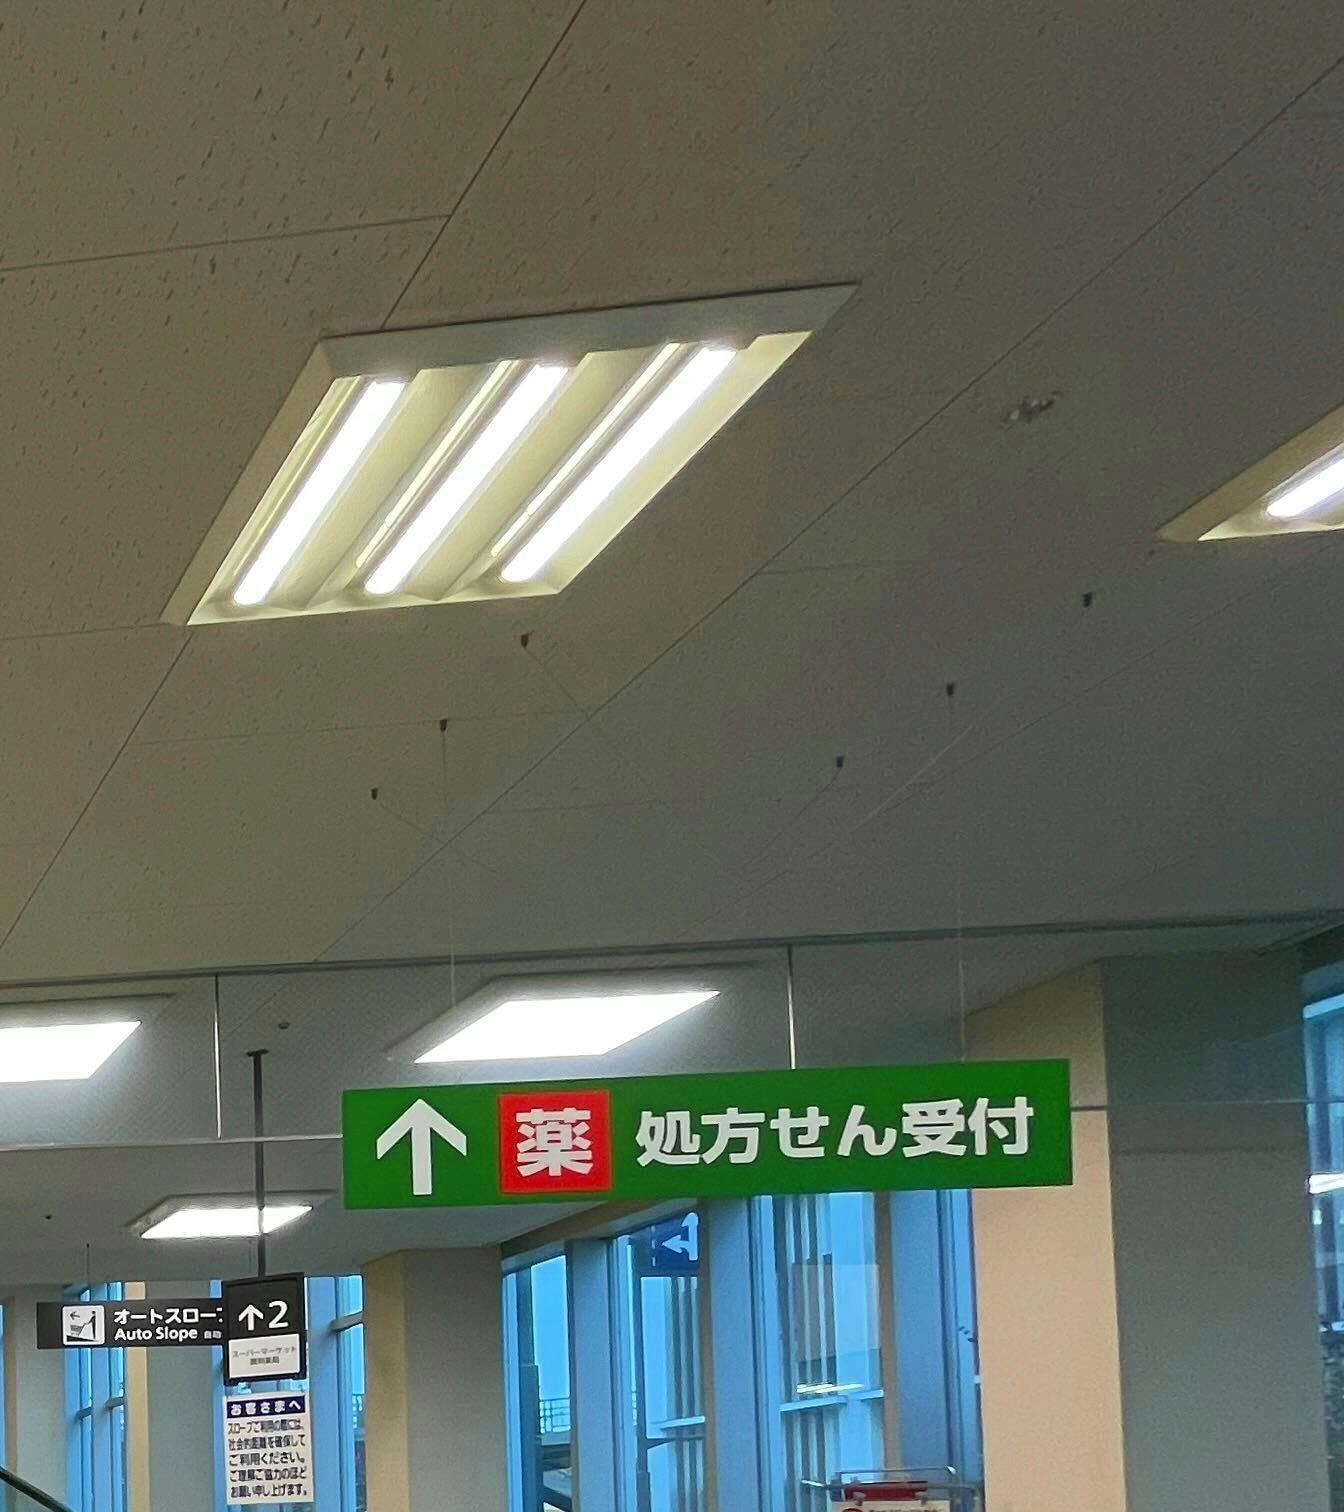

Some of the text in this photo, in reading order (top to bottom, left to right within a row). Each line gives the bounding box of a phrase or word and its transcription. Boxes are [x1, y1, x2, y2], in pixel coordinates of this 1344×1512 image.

[516, 1096, 1034, 1177] 薬 処方せん受付
[113, 1307, 223, 1325] オートスロー
[268, 1300, 289, 1329] 2
[114, 1327, 152, 1340] Auto
[155, 1327, 198, 1342] Slope
[230, 1399, 302, 1416] お客さまへ
